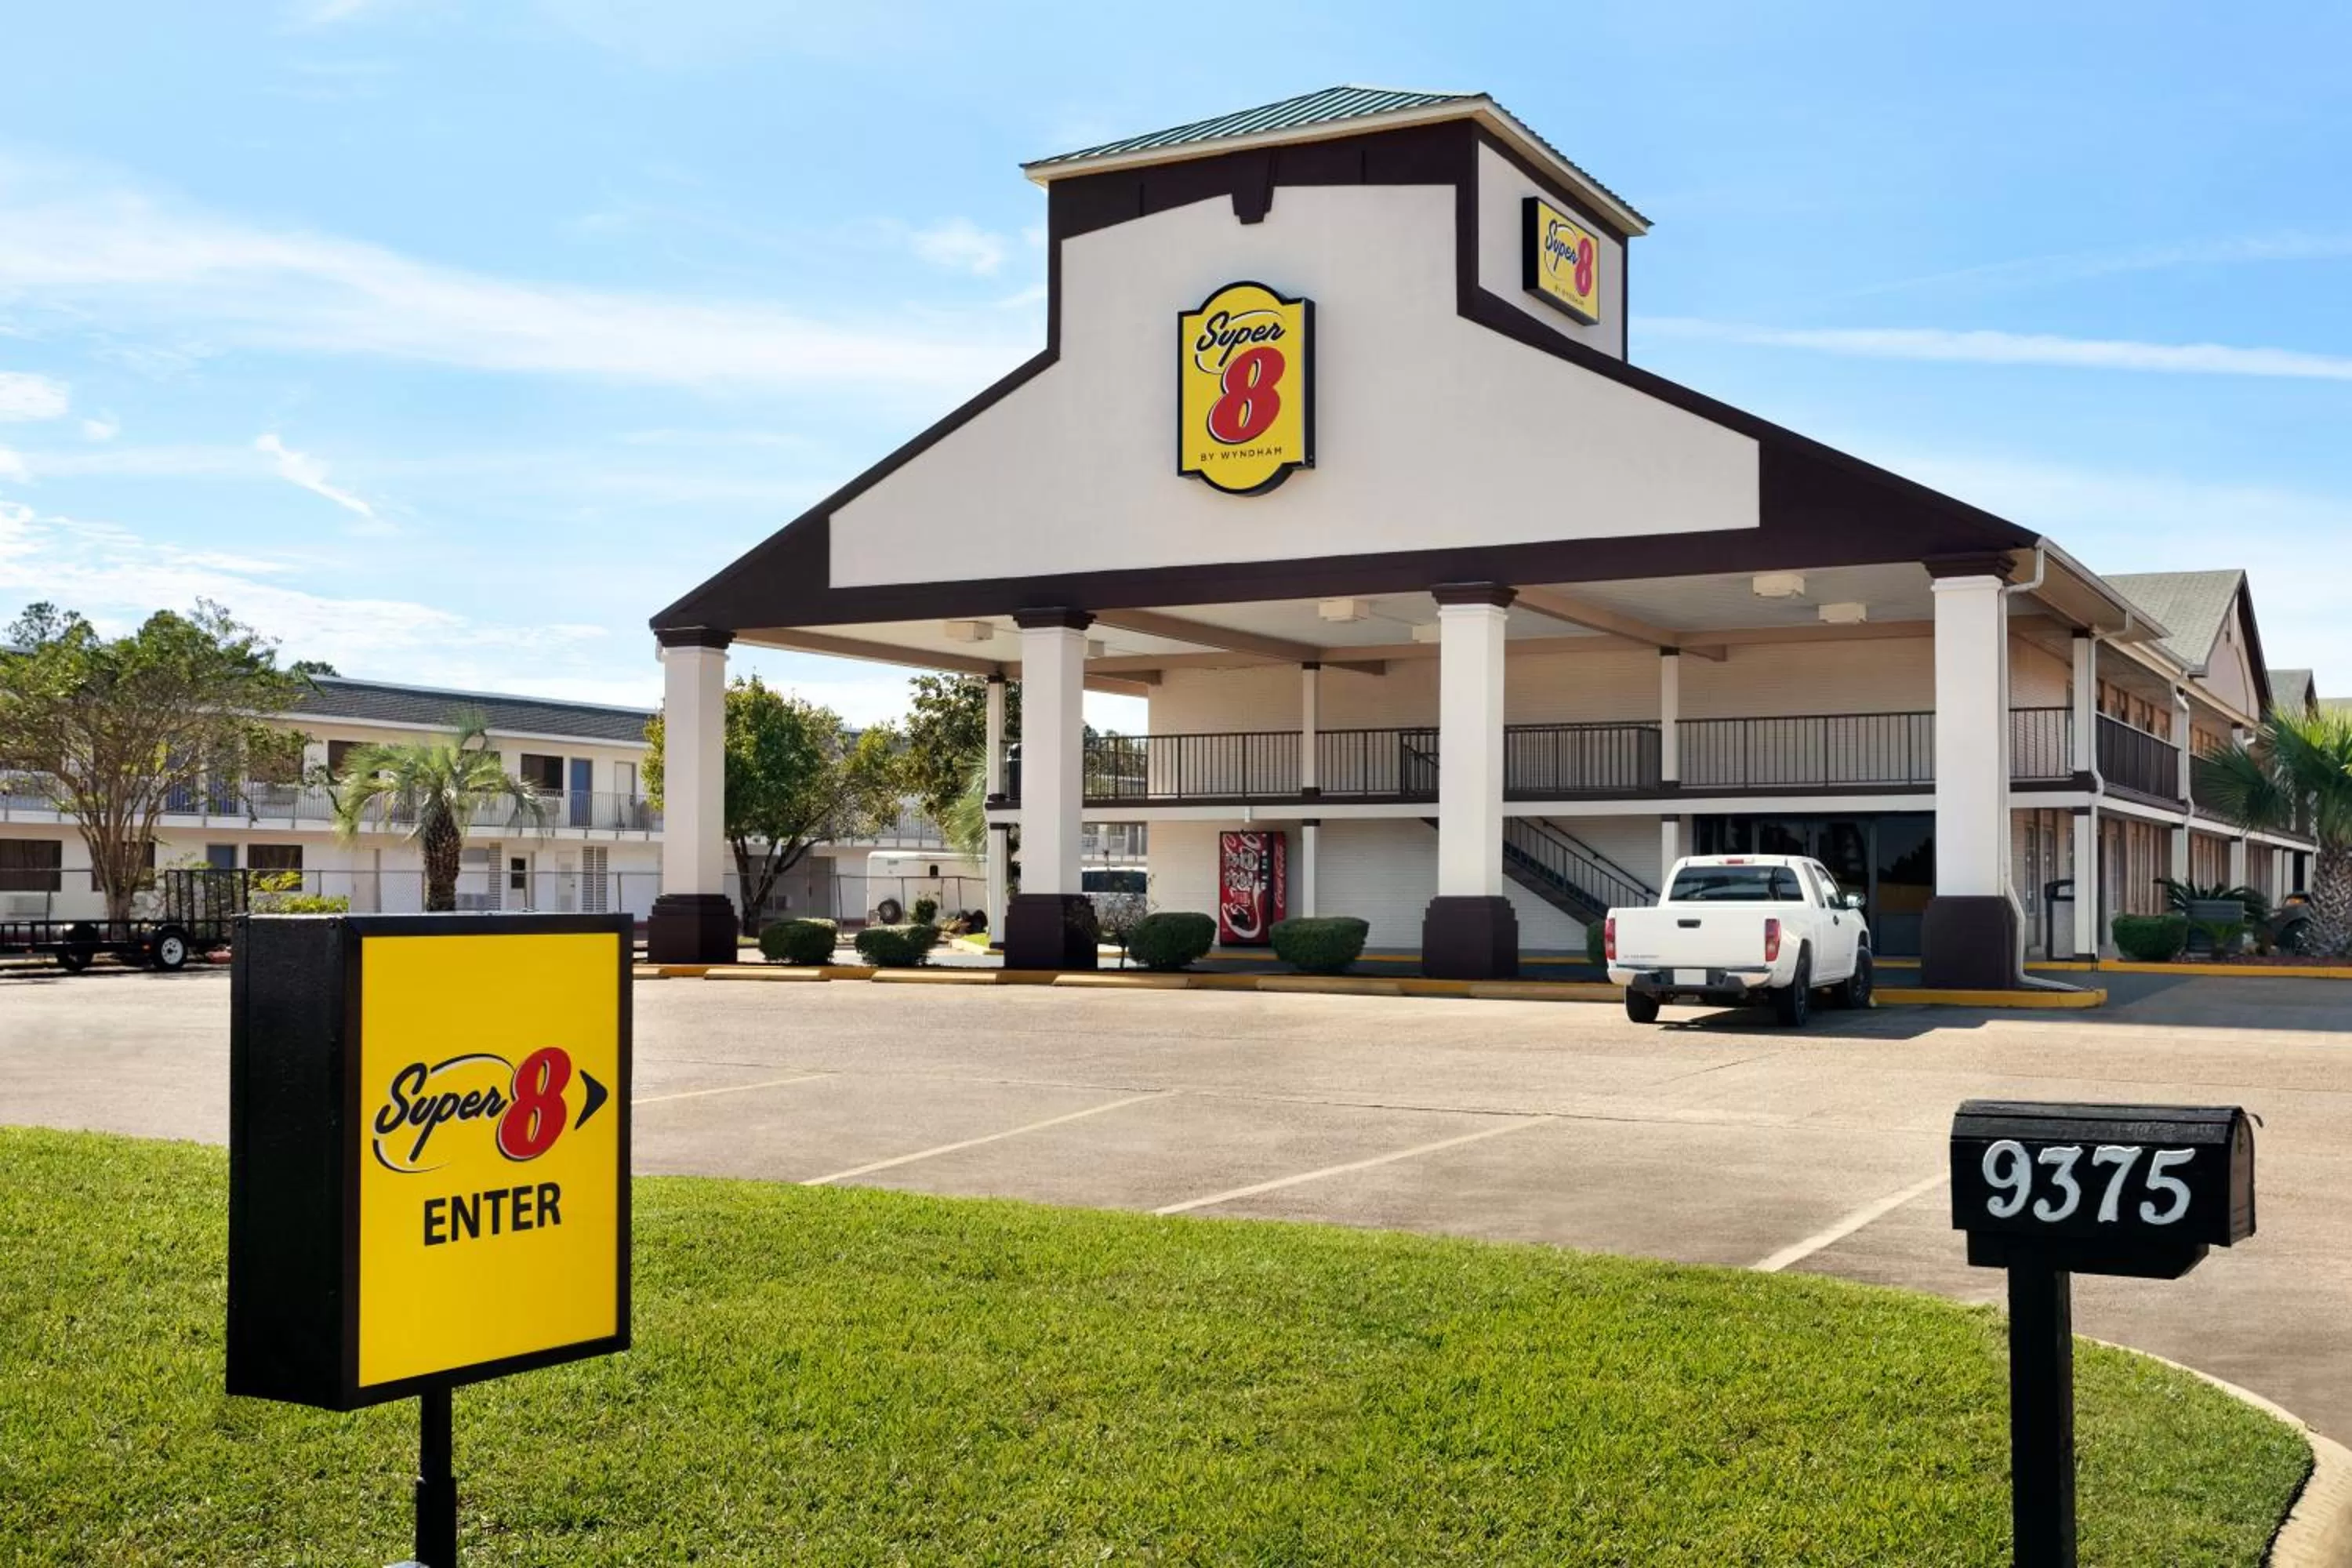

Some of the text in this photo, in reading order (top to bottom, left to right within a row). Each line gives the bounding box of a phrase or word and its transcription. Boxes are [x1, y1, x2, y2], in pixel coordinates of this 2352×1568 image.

[1544, 219, 1594, 297] Super 8
[1195, 310, 1287, 367] Super
[1206, 346, 1286, 445] 8
[1200, 446, 1283, 462] BY WYNDHAM
[374, 1047, 572, 1163] Super 8
[423, 1181, 562, 1247] ENTER
[1982, 1139, 2195, 1225] 9375
